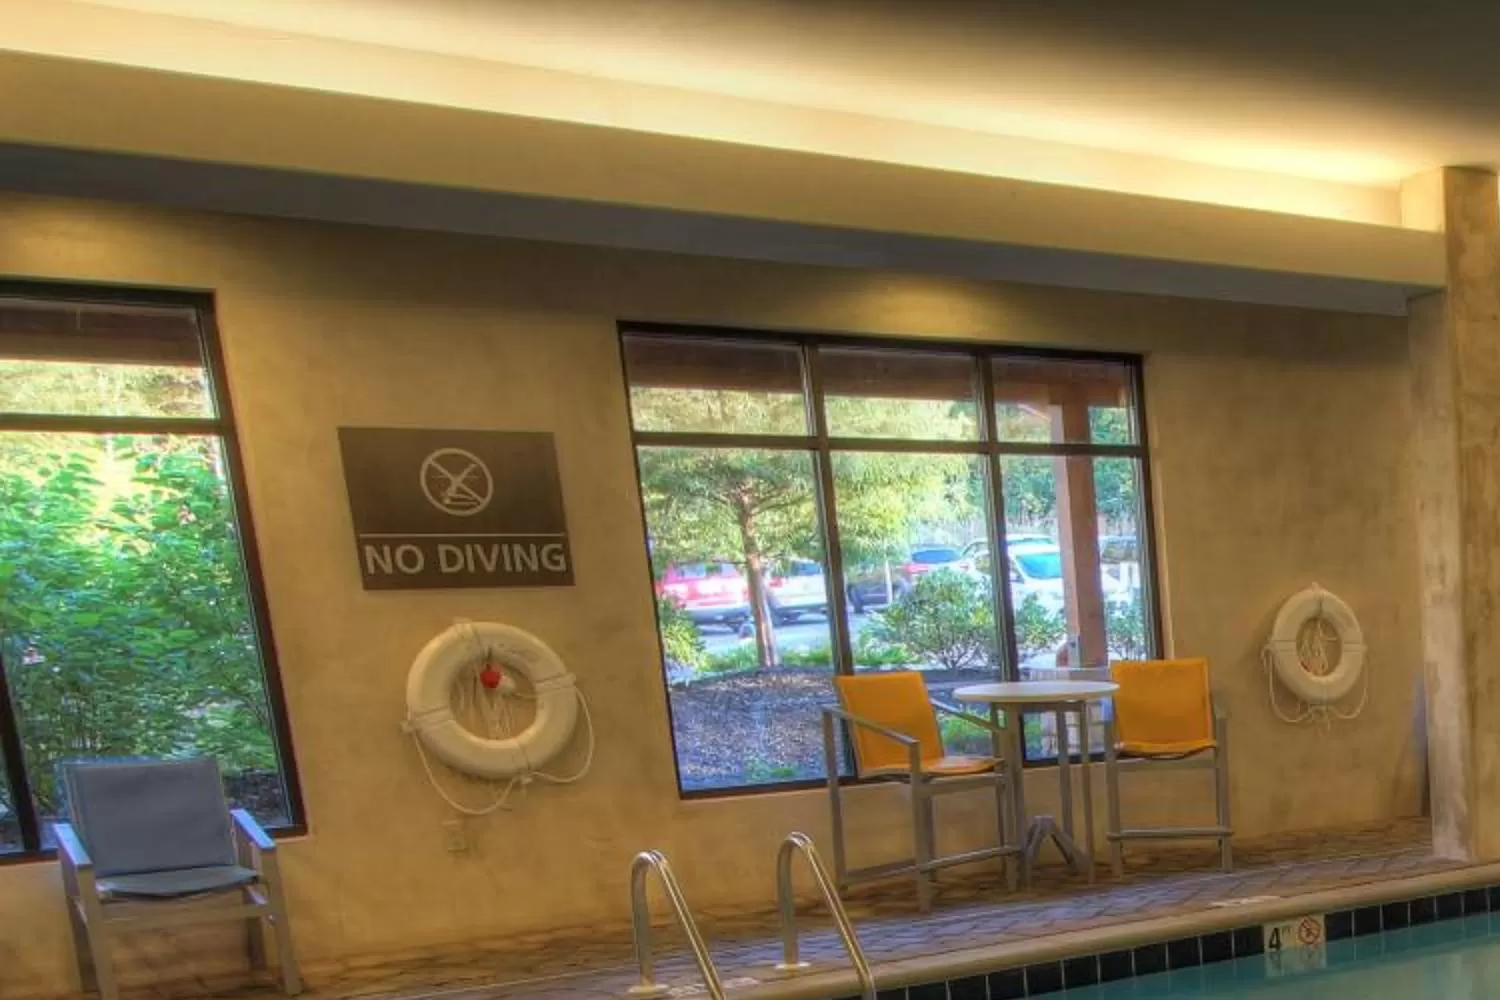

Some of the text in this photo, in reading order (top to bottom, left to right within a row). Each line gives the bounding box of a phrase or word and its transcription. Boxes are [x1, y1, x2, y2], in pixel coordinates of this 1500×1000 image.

[365, 543, 567, 574] NO DIVING
[1269, 927, 1281, 949] 4
